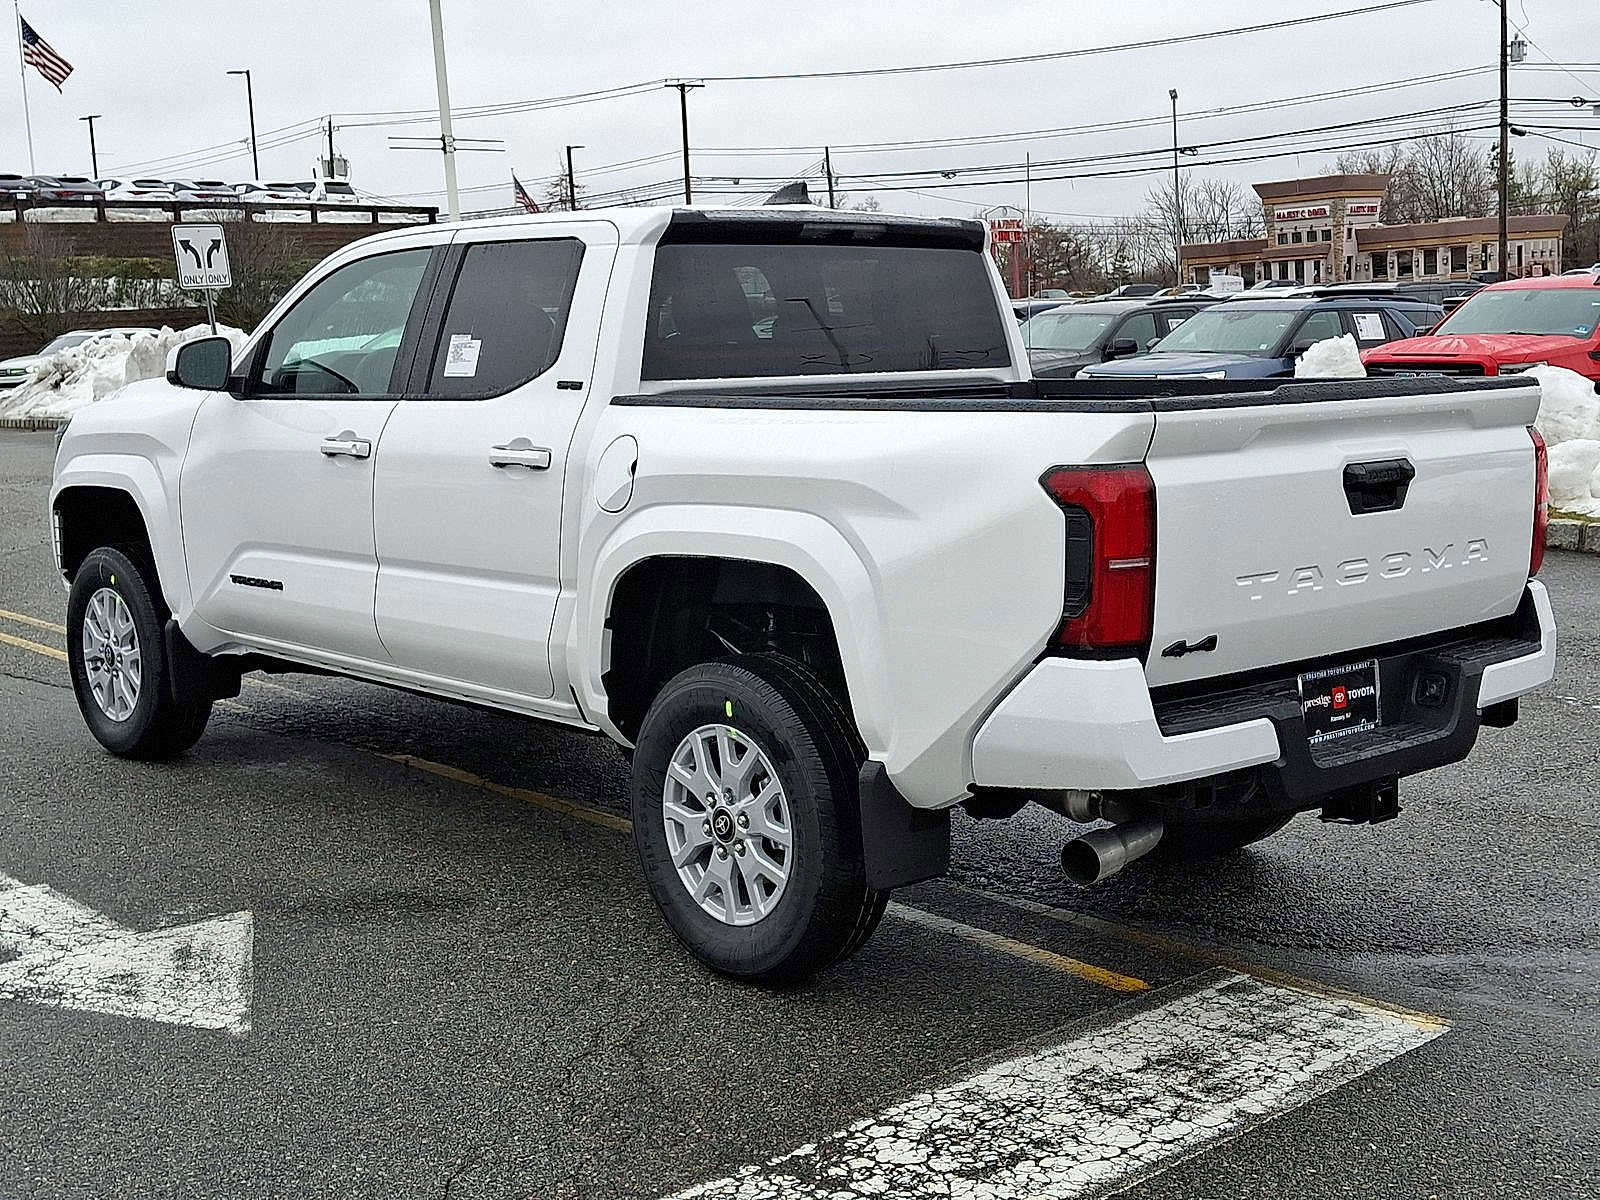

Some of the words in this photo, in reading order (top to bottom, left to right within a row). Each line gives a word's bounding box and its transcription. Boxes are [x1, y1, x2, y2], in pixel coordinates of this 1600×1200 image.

[183, 275, 204, 285] ONLY
[208, 273, 227, 283] ONLY
[1235, 538, 1489, 600] TACOMA
[229, 574, 284, 591] TACOMA
[1304, 694, 1332, 713] prestige
[1347, 685, 1375, 700] TOYOTA
